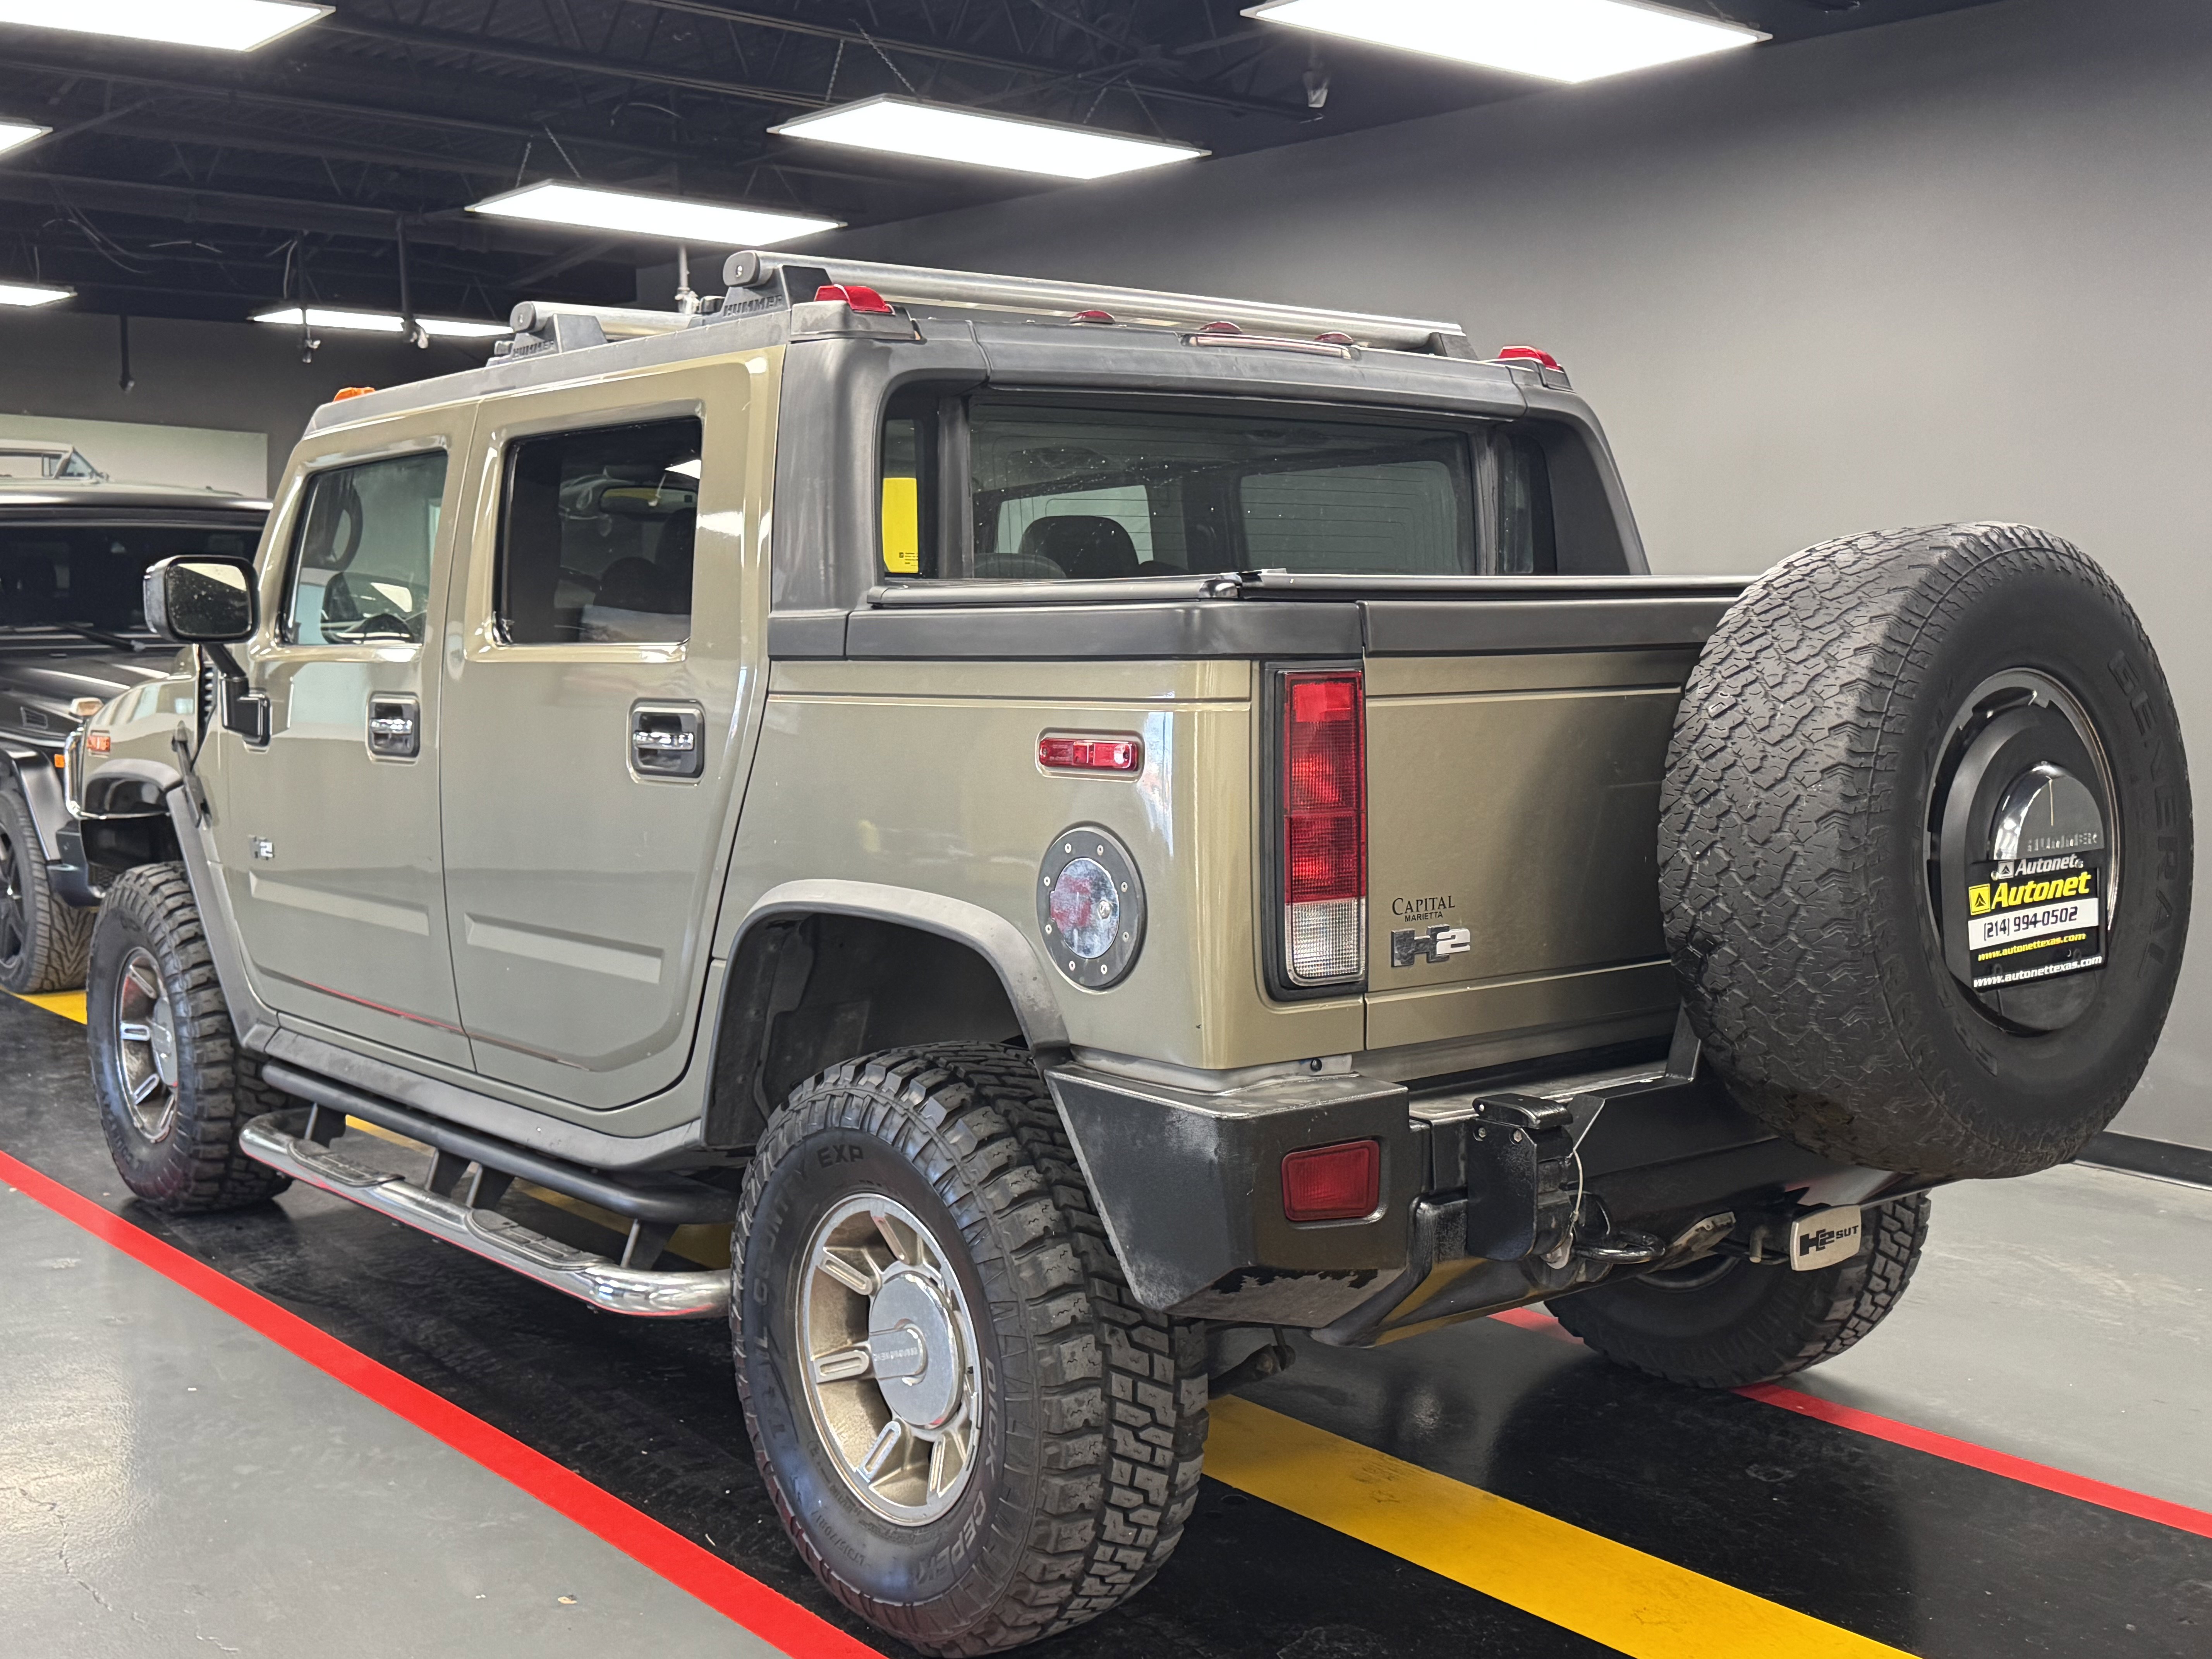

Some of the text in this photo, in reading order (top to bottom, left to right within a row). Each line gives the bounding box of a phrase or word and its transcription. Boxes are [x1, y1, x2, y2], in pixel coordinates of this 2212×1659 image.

[723, 295, 783, 317] HUMMER
[2015, 853, 2077, 876] Autonet
[1392, 895, 1455, 915] CAPITAL
[1991, 871, 2092, 909] Autonet
[1404, 911, 1443, 922] MARIETTA
[1983, 906, 2078, 941] (214) 994-0502
[1391, 924, 1470, 967] H2
[1978, 933, 2086, 962] www.autonettexas.com
[1973, 955, 2102, 988] www.autonettexas.com
[817, 1144, 863, 1168] EXP
[1800, 1225, 1859, 1256] H2 SUT
[917, 1356, 998, 1585] DICK CEPEK
